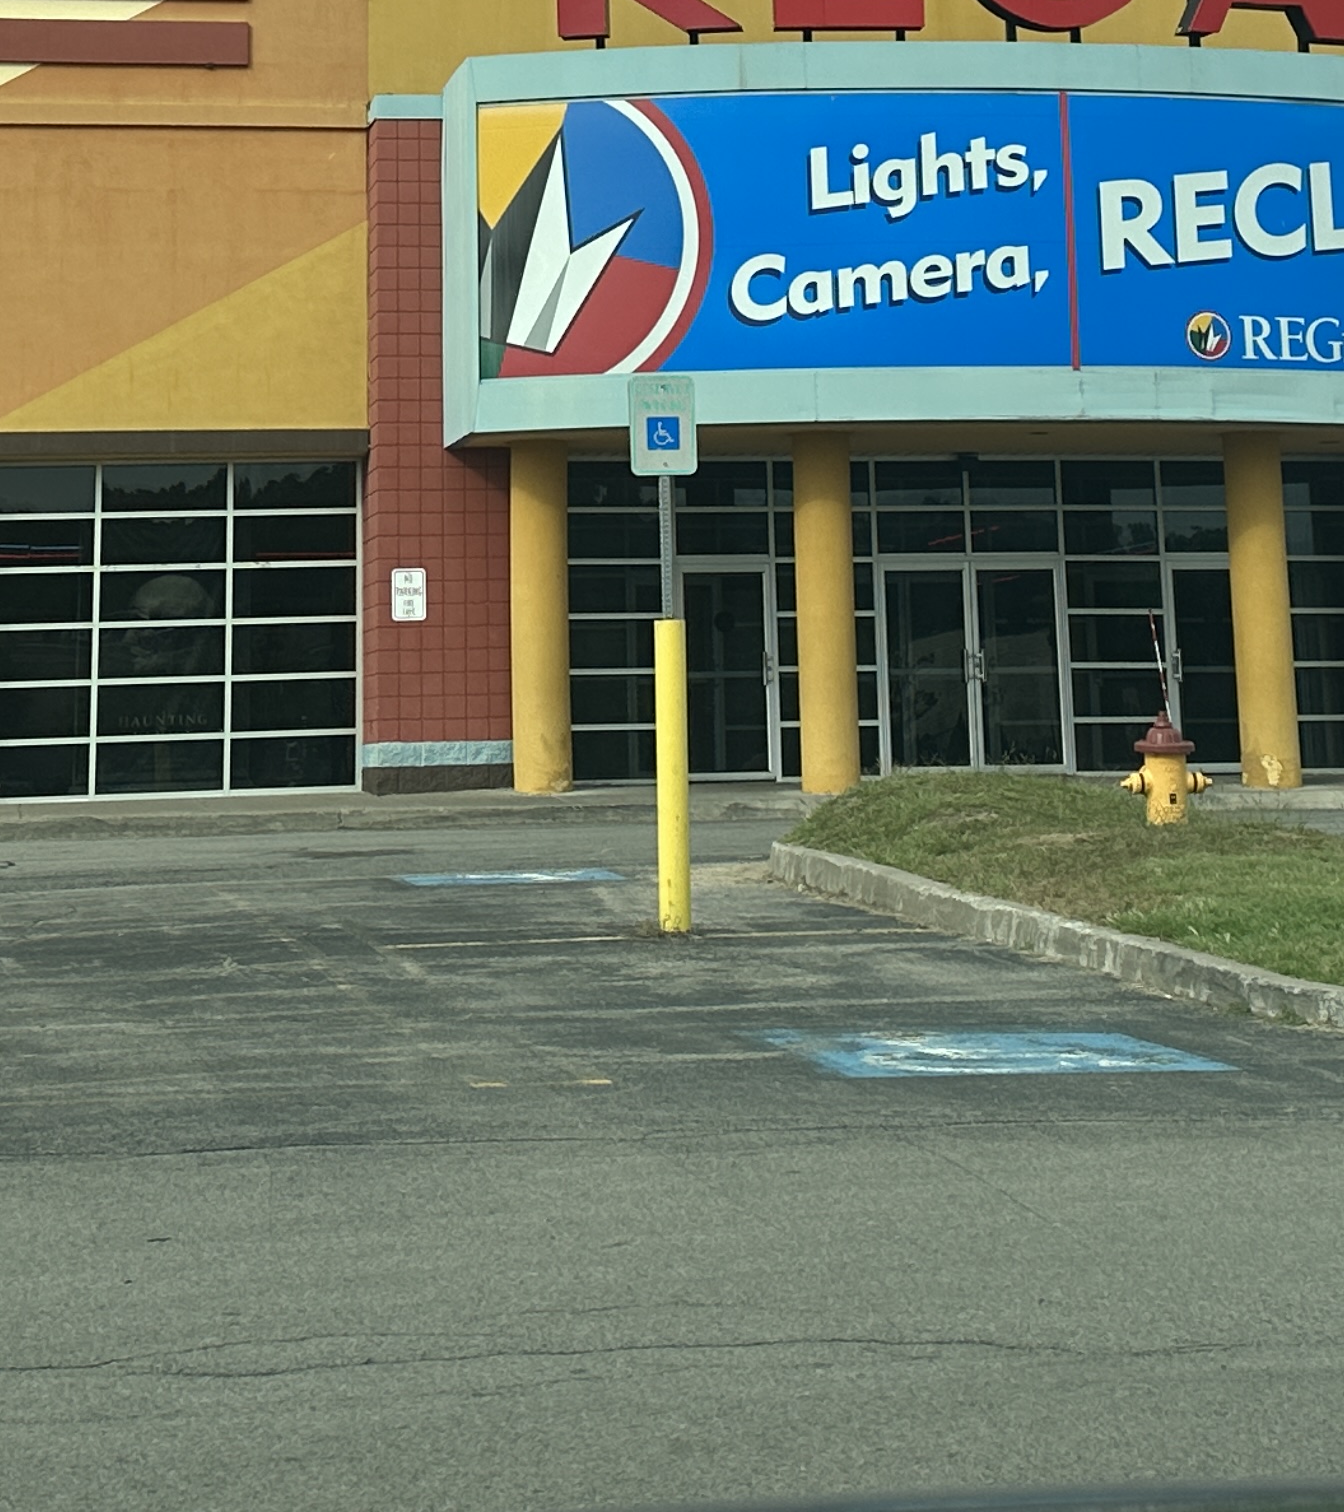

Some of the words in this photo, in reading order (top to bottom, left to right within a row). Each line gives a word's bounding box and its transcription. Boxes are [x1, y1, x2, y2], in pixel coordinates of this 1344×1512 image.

[808, 131, 1049, 221] Lights,
[729, 245, 1050, 324] Camera,
[118, 713, 208, 728] HAUNTING
